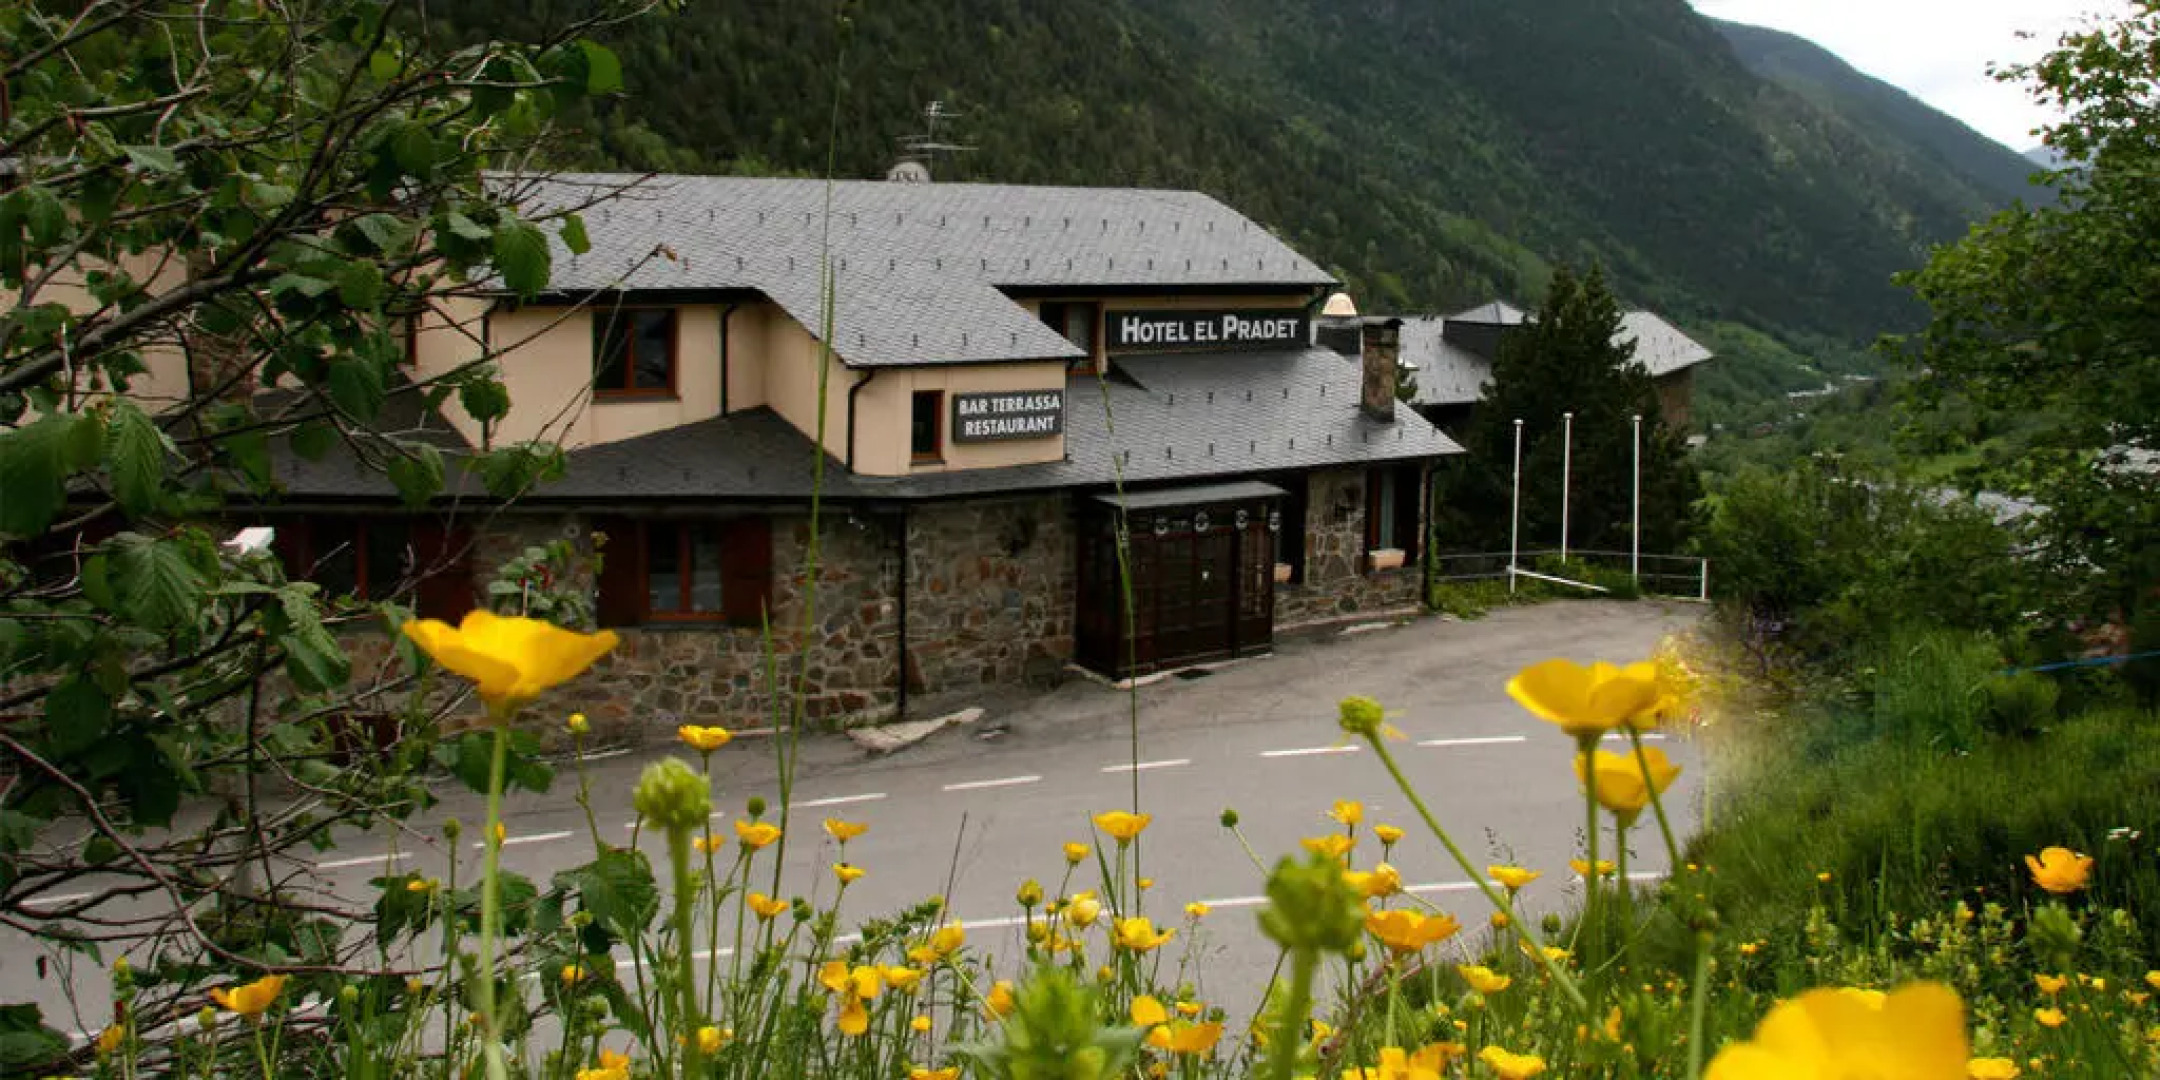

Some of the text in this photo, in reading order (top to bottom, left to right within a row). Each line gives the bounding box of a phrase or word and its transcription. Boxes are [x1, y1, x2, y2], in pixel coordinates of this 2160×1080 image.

[1121, 314, 1298, 343] HOTEL EL PRADET
[960, 394, 1060, 414] BAR TERRASSA
[965, 415, 1055, 436] RESTAURANT
